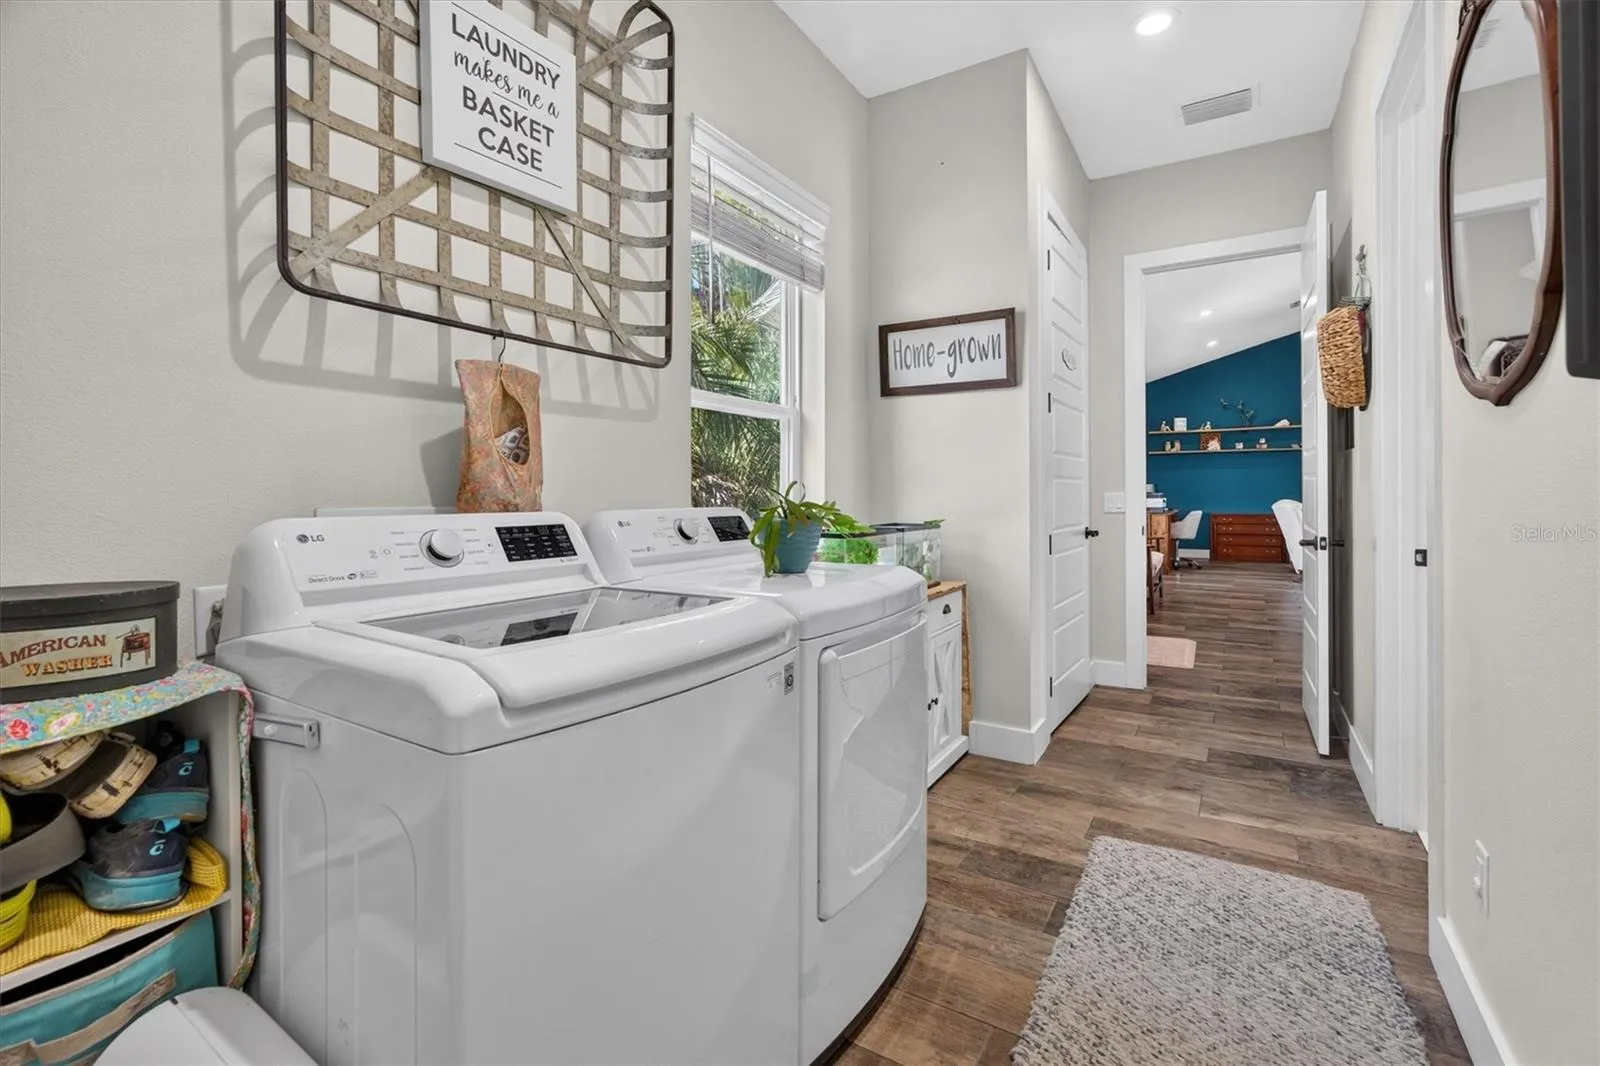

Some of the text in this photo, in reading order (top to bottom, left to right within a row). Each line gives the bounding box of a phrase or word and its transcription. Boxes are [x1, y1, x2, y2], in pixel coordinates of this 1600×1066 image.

[452, 13, 561, 90] LAUNDRY
[454, 51, 560, 119] makes me a
[463, 85, 554, 147] BASKET
[478, 127, 543, 172] CASE
[893, 333, 1001, 378] Home-grown
[20, 655, 113, 677] WASHER
